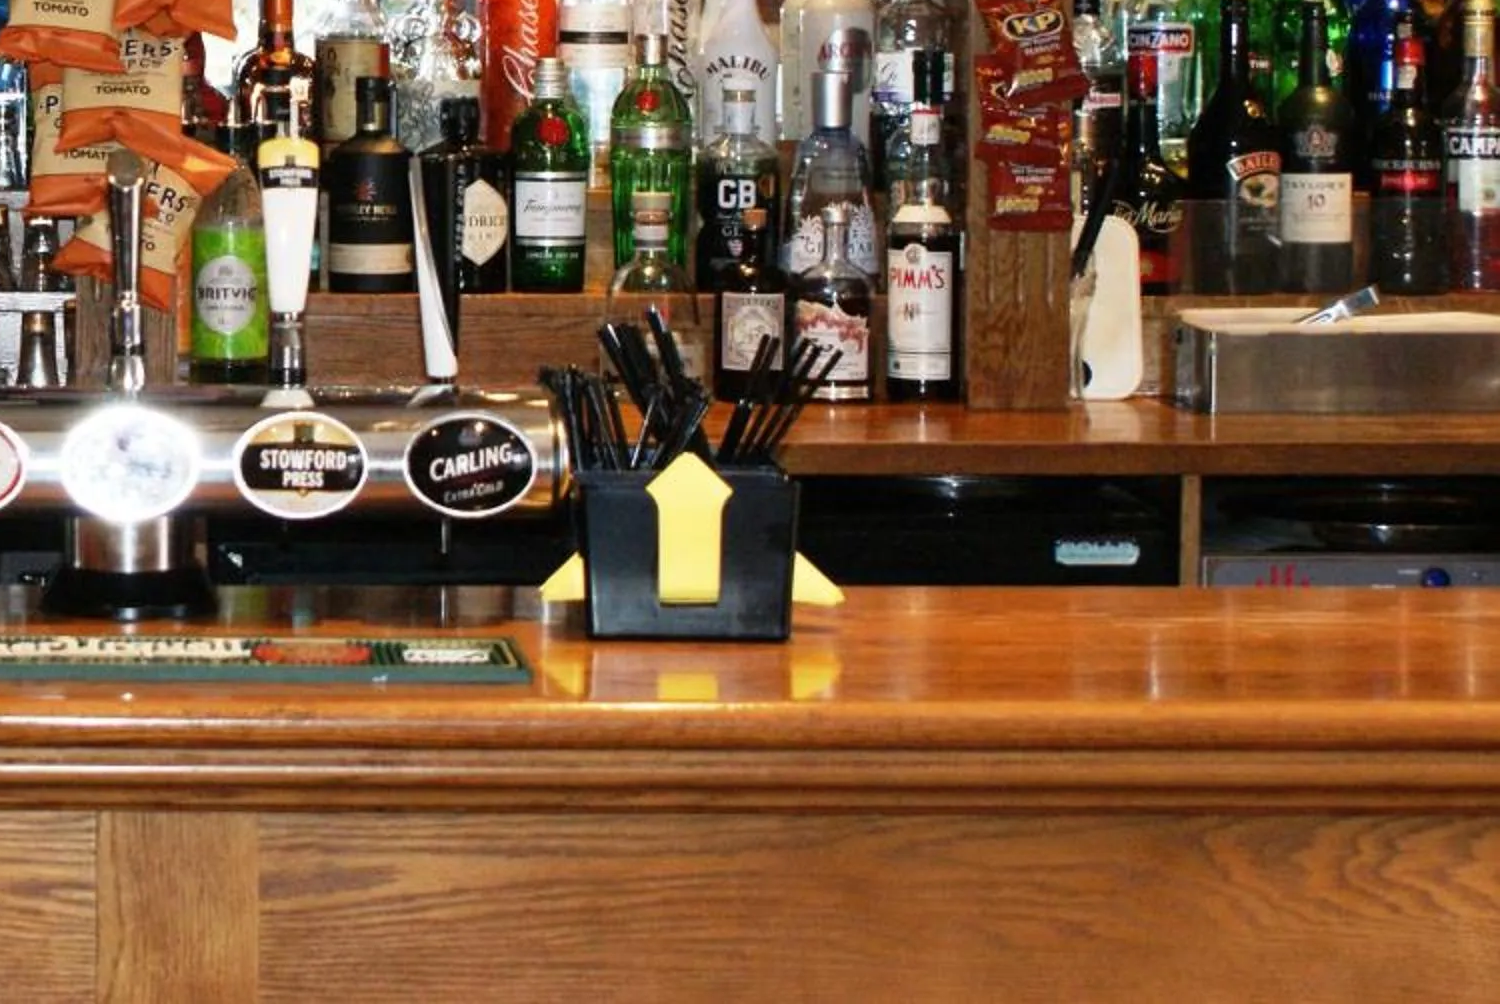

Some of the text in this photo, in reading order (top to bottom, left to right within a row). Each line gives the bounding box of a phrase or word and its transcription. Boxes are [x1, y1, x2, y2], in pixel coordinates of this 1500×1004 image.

[33, 1, 89, 17] TOMATO
[1011, 11, 1057, 35] KP
[124, 40, 172, 57] ERS
[706, 55, 770, 81] MALIBU
[95, 85, 151, 95] TOMATO
[63, 149, 109, 161] TOMAT
[1450, 136, 1500, 155] CAMP
[1237, 152, 1277, 174] BAILE
[146, 181, 187, 212] ERS
[890, 264, 945, 289] PIMM'S
[198, 287, 258, 299] BRITVIC
[260, 449, 347, 470] STOWFORD
[429, 443, 513, 482] CARLING
[282, 472, 324, 488] PRESS
